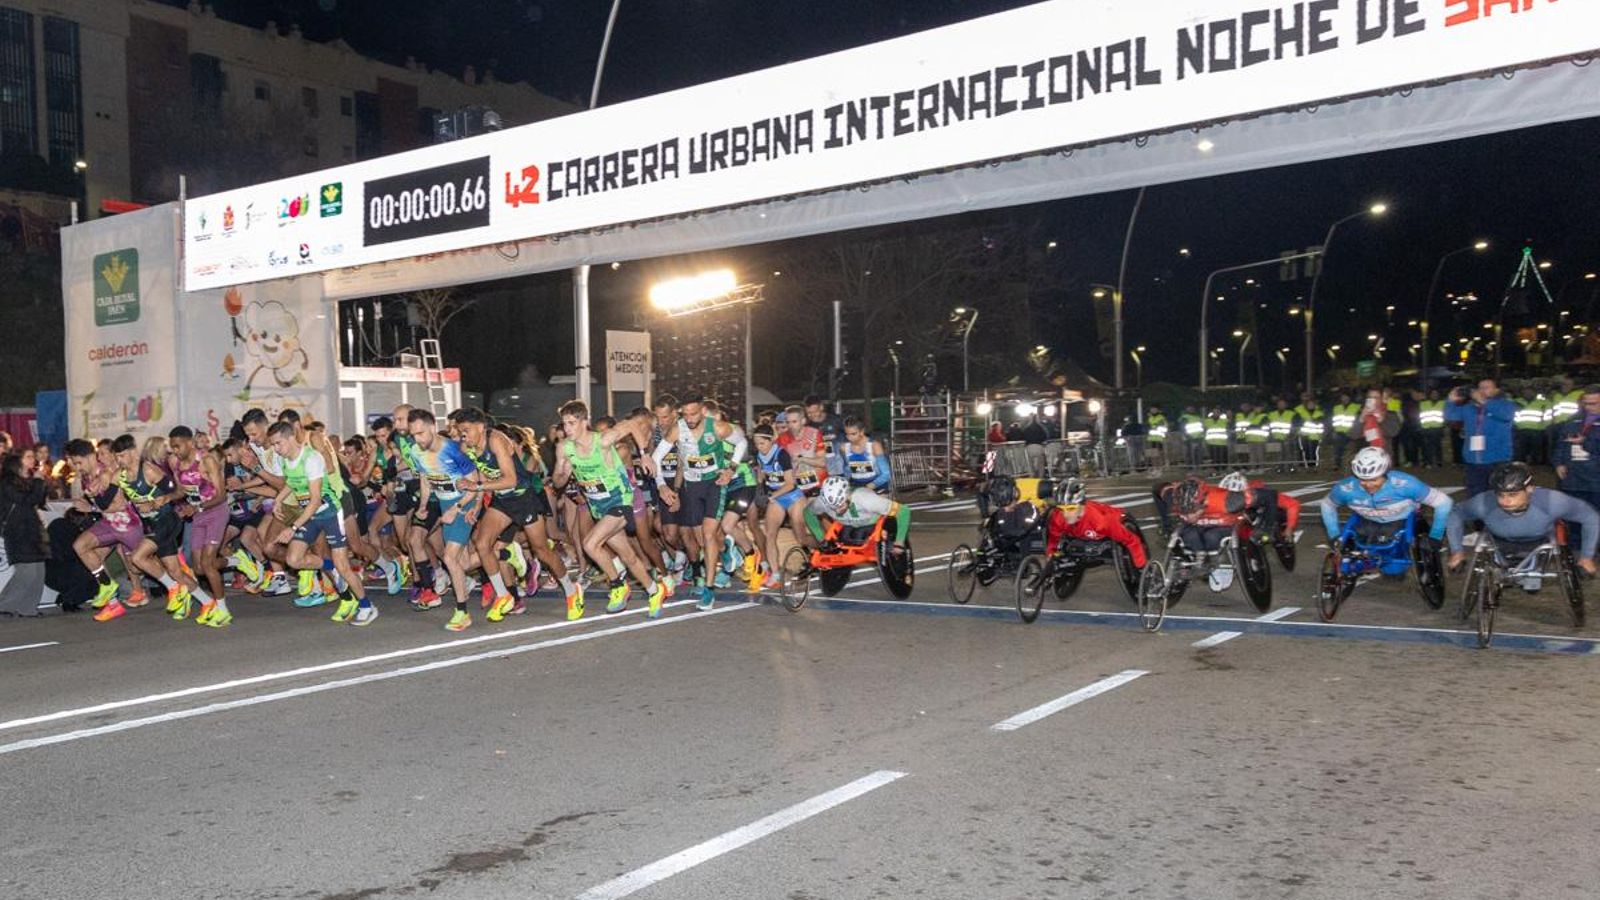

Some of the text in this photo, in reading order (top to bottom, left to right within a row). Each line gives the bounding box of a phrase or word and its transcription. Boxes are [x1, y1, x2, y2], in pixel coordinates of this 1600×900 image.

[505, 164, 540, 208] 42
[547, 137, 679, 202] CARRERA
[689, 109, 814, 175] URBANA
[823, 36, 1162, 150] INTERNACIONAL
[1176, 0, 1339, 81] NOCHE
[1356, 0, 1426, 45] DE
[369, 175, 487, 229] 00:00:00.66
